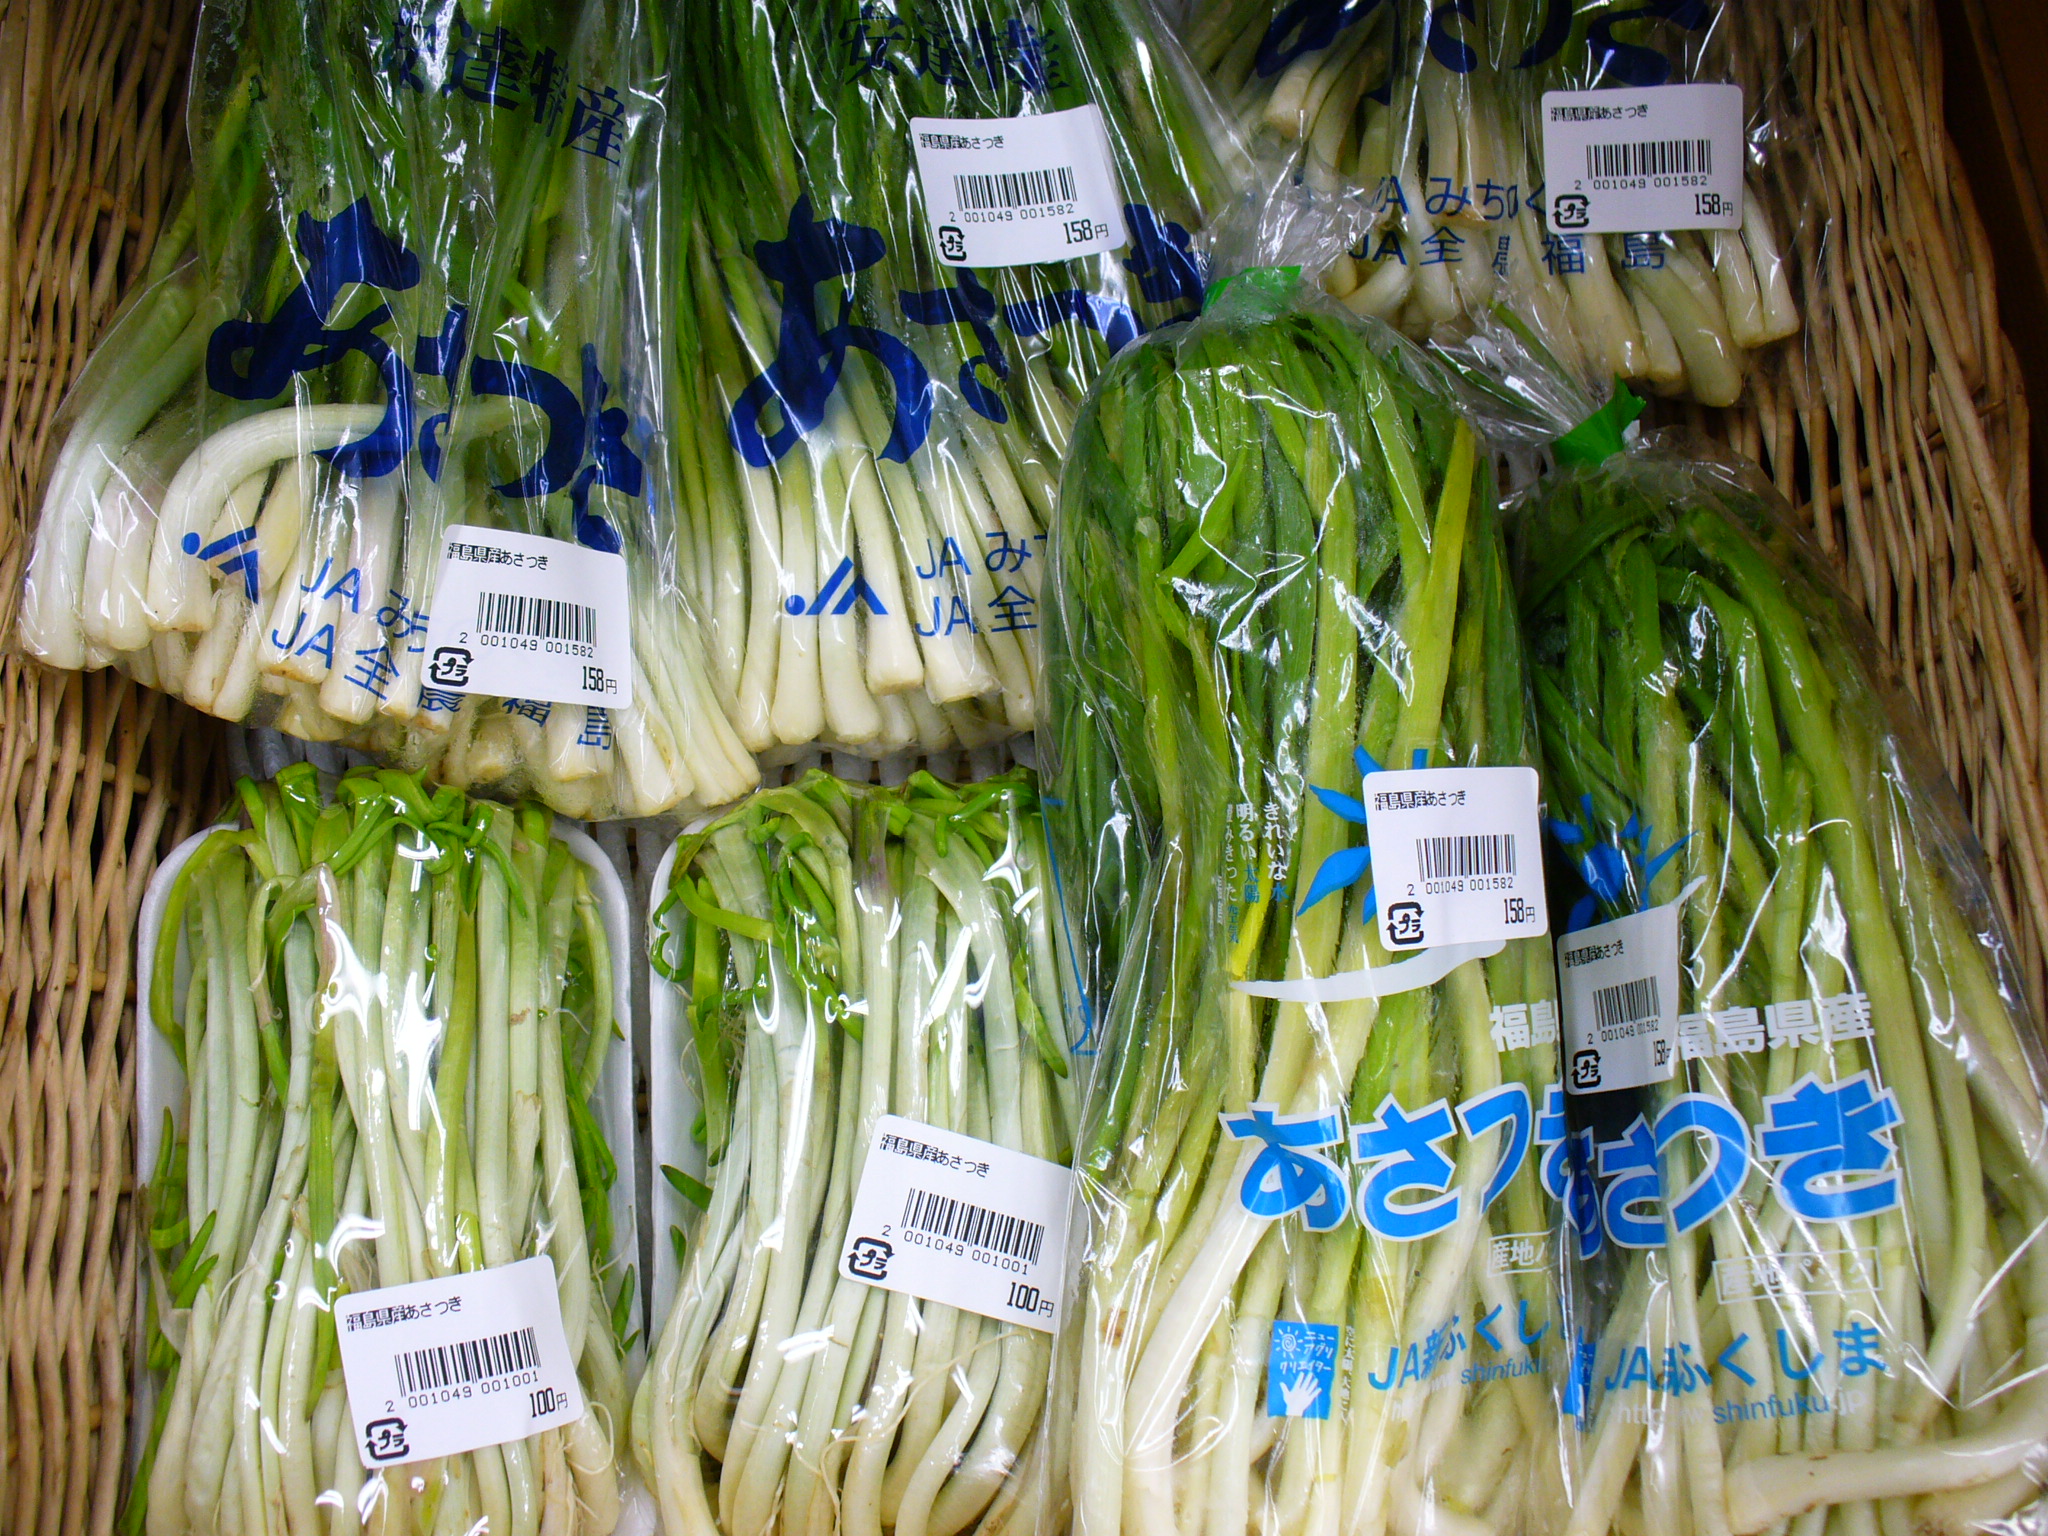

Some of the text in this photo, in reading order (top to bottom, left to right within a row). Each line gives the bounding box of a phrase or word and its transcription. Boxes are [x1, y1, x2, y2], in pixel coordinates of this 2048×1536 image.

[1574, 176, 1708, 190] 2 001049 001582
[949, 203, 1075, 223] 2 001049 001582
[1694, 193, 1734, 217] 158円
[1063, 218, 1109, 245] 158円
[915, 531, 1048, 580] JA み
[300, 557, 361, 613] JA
[915, 595, 979, 637] JA
[272, 612, 335, 669] JA
[459, 632, 594, 658] 2 001049 001582
[582, 665, 618, 695] 158円
[1406, 877, 1514, 896] 2 001049 001582
[1504, 897, 1535, 925] 158円
[1587, 1032, 1594, 1045] 2
[1601, 1025, 1636, 1042] 001049
[881, 1224, 1029, 1276] 2 001049 001001
[1006, 1281, 1055, 1319] 100円
[385, 1370, 539, 1413] 2 001049 001001
[529, 1387, 568, 1418] 100円
